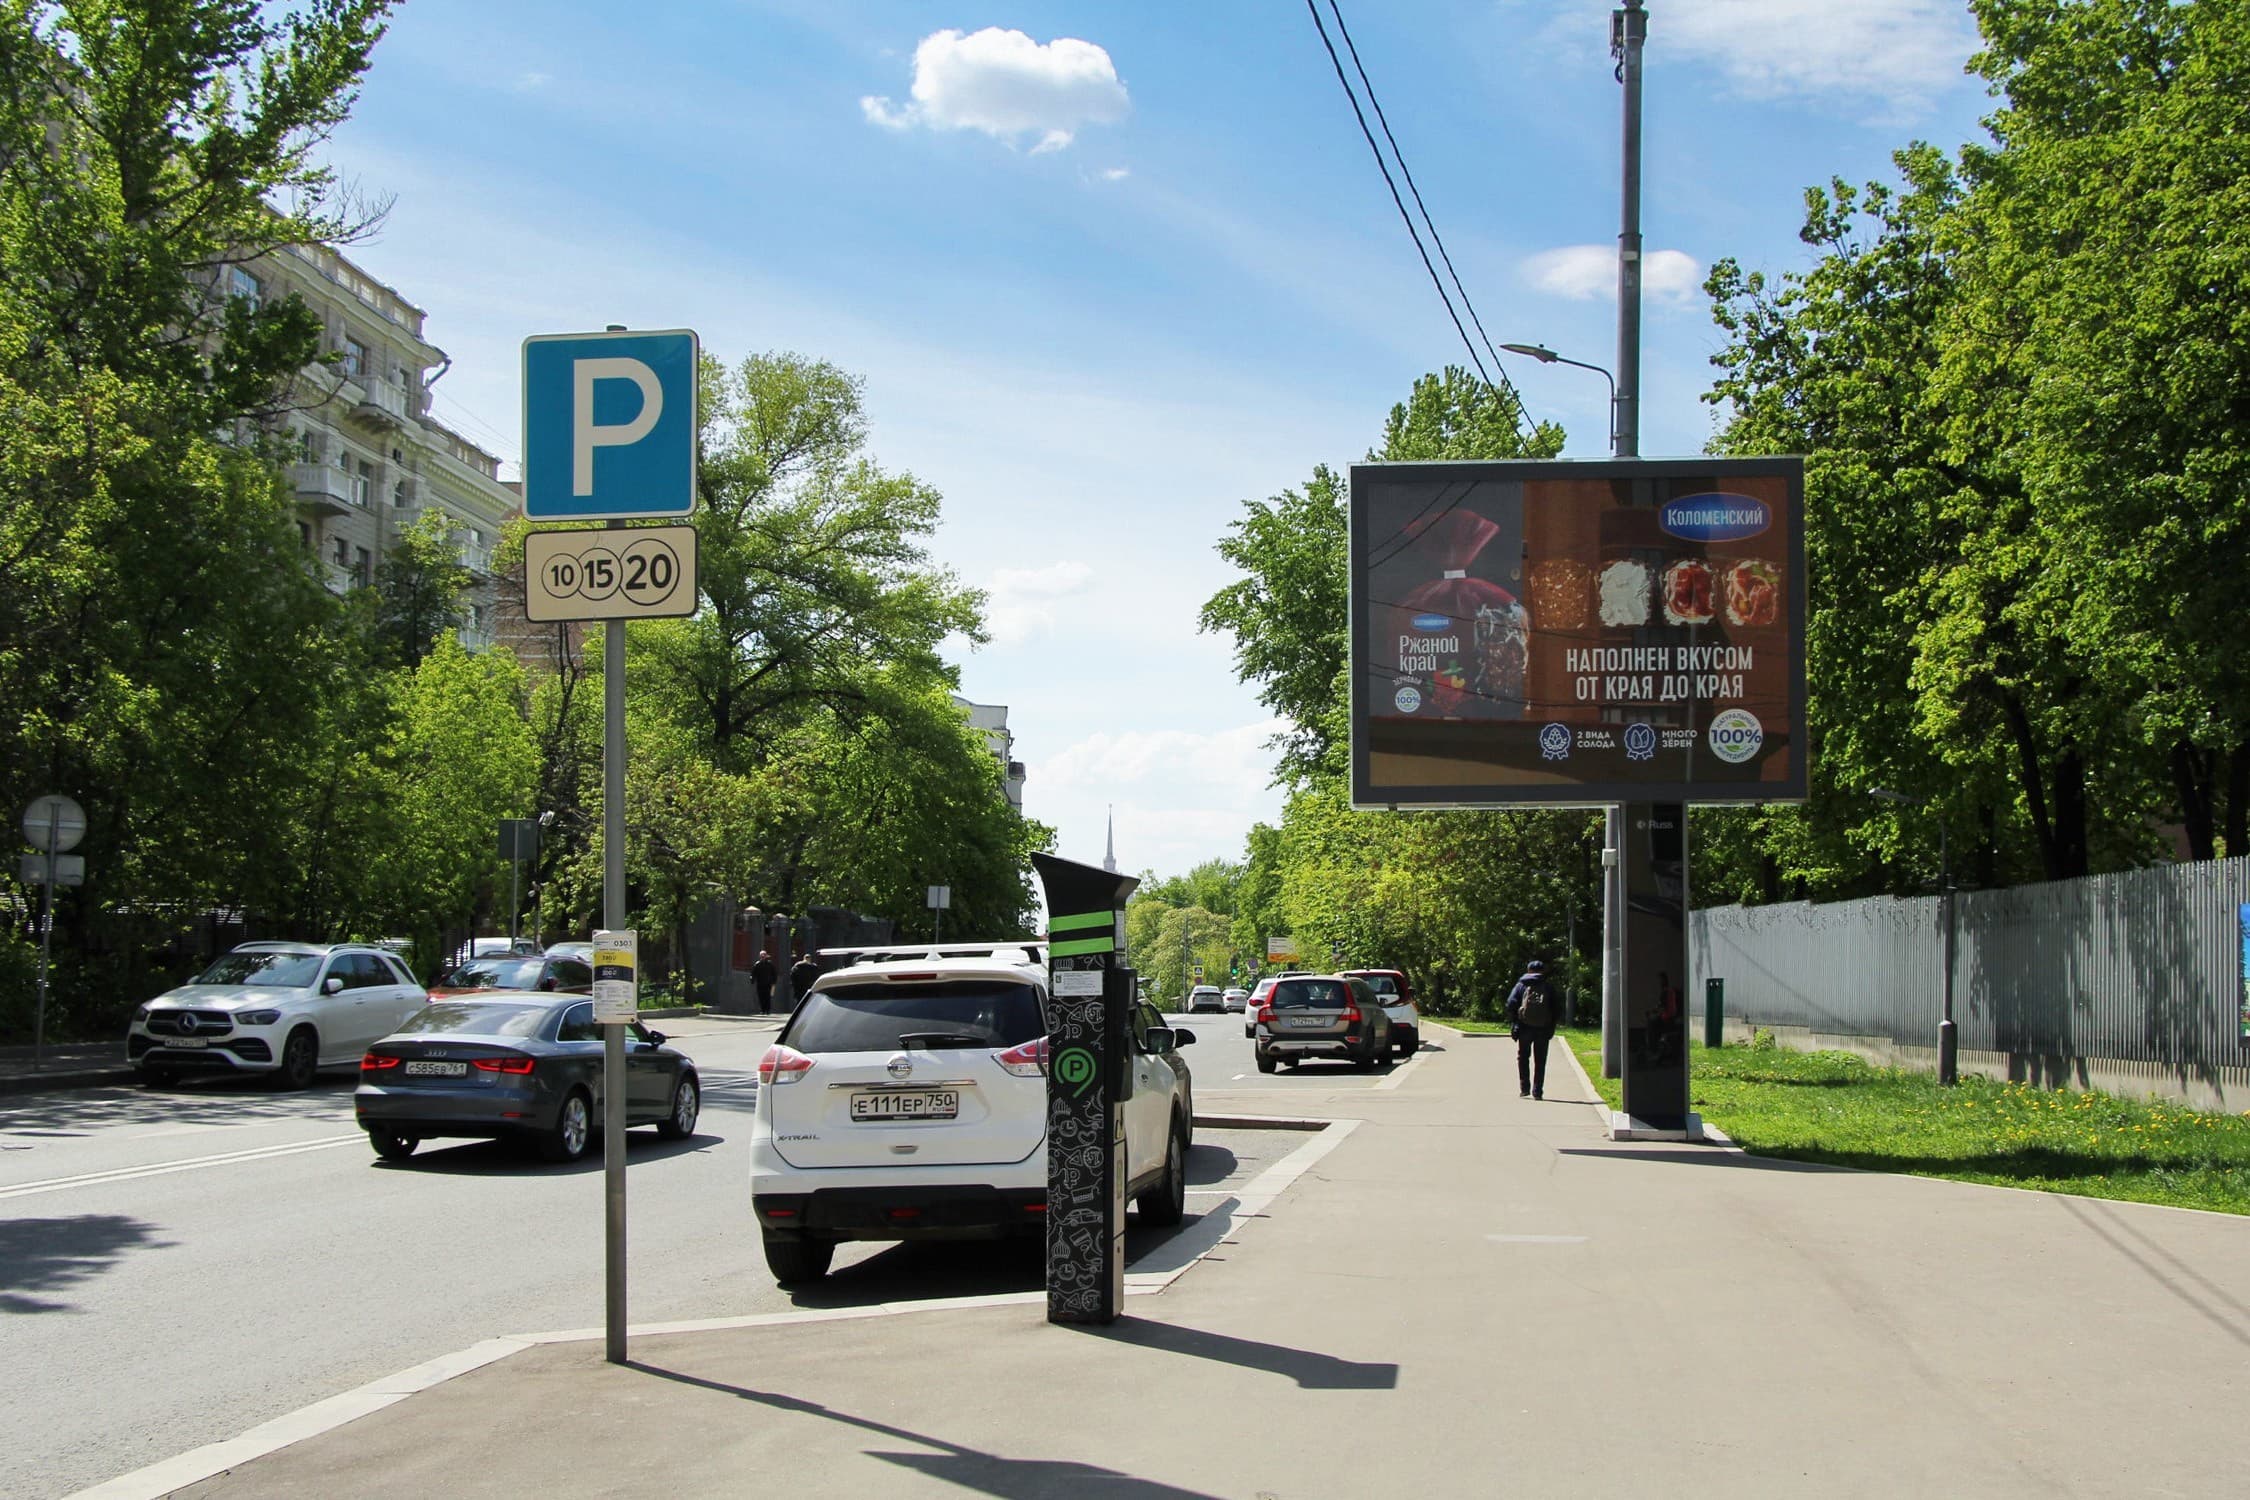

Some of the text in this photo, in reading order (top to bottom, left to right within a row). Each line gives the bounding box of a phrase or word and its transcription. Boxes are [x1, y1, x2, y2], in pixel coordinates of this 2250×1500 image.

[573, 358, 663, 496] P
[551, 553, 672, 590] 10 15 20
[1400, 635, 1459, 653] Ржаной
[1400, 654, 1437, 674] край
[1566, 646, 1753, 672] НАПОЛНЕН ВКУСОМ
[1576, 675, 1743, 701] ОТ КРАЯ ДО КРАЯ
[1577, 731, 1611, 740] 2 ВИДА
[1662, 729, 1698, 739] МНОГО
[1711, 729, 1762, 744] 100%
[1576, 740, 1616, 749] СОЛОДА
[1069, 1060, 1084, 1077] P
